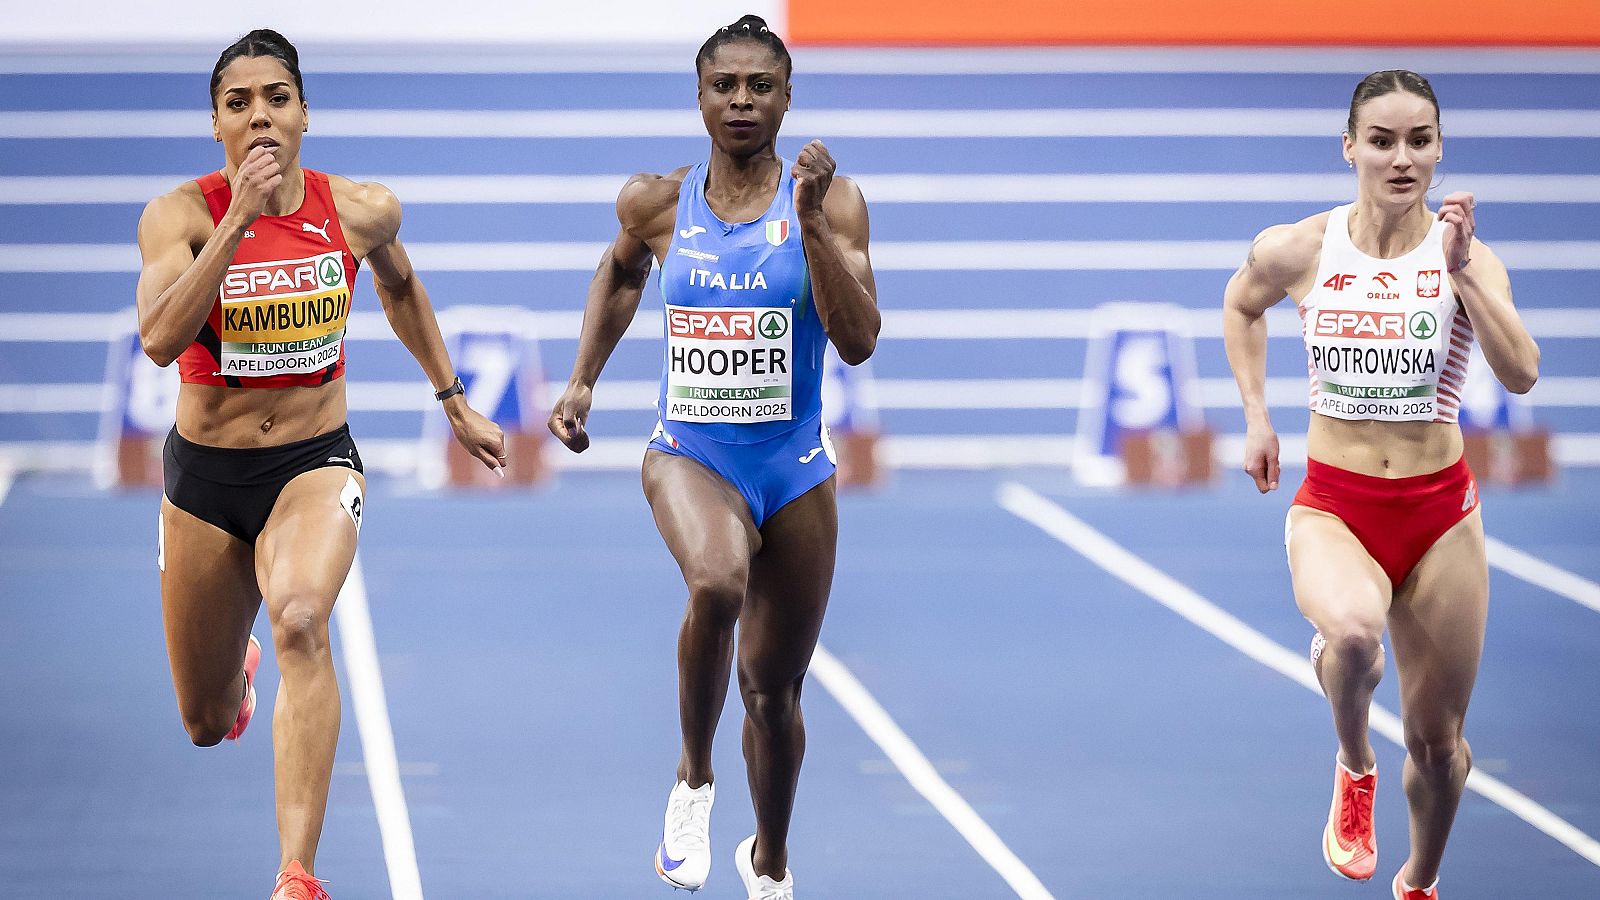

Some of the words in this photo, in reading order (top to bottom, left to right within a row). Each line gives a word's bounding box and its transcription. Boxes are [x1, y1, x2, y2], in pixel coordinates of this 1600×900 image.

[224, 264, 317, 295] SPAR
[689, 268, 768, 290] ITALIA
[1323, 273, 1357, 291] 4F
[224, 293, 346, 331] KAMBUNDJI
[671, 312, 753, 336] SPAR
[1316, 312, 1404, 337] SPAR
[227, 355, 316, 371] APELDOORN
[317, 344, 339, 364] 2025
[251, 343, 255, 353] I
[257, 342, 285, 353] RUN
[1312, 345, 1436, 374] PIOTROWSKA
[672, 346, 787, 375] HOOPER
[459, 341, 513, 421] 7
[689, 388, 693, 398] I
[694, 388, 718, 398] RUN
[1342, 386, 1366, 398] RUN
[672, 403, 752, 417] APELDOORN
[755, 403, 787, 416] 2025
[1320, 398, 1399, 415] APELDOORN
[1402, 402, 1433, 415] 2025
